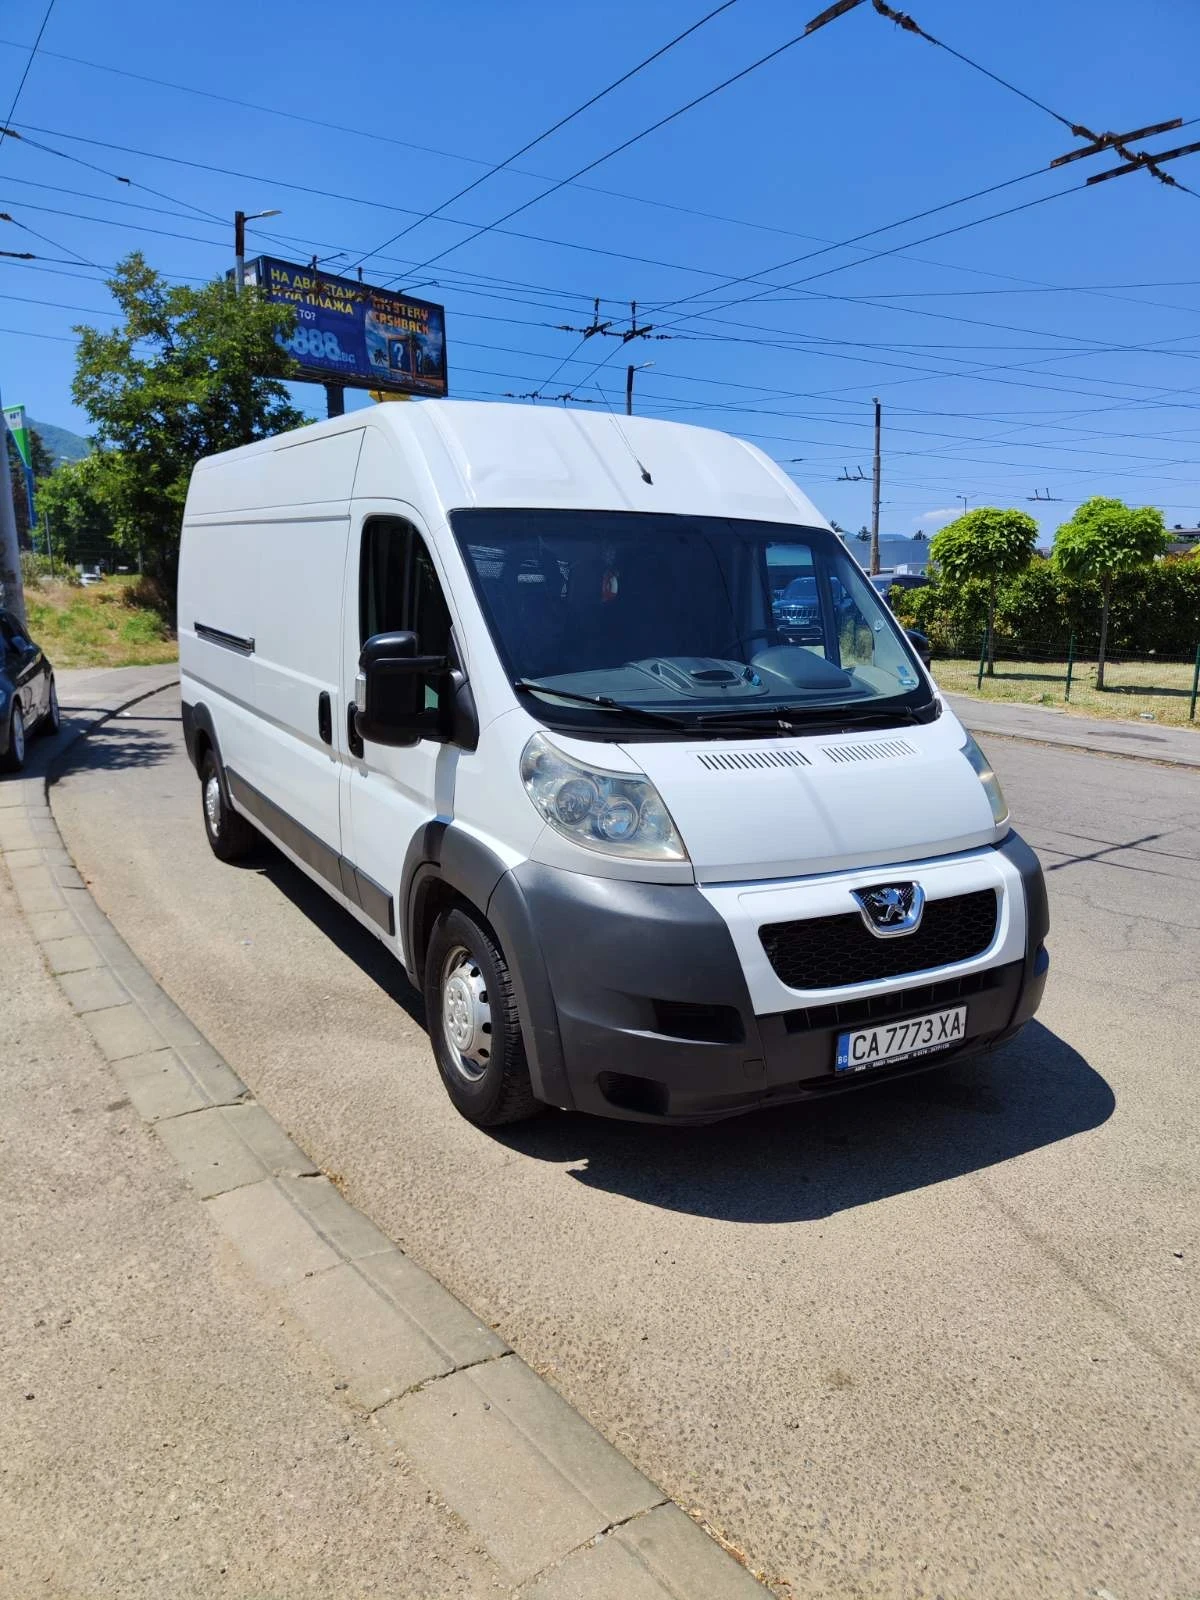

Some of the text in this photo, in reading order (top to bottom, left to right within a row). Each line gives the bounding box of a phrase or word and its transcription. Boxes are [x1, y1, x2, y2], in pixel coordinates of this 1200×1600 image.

[270, 267, 290, 284] НА
[306, 292, 354, 315] ПЛАЖА
[299, 308, 316, 321] ТО?
[371, 311, 430, 336] CASHBACK
[852, 1031, 879, 1061] CA
[884, 1018, 934, 1054] 7773
[937, 1011, 961, 1041] XA
[837, 1054, 848, 1065] BG
